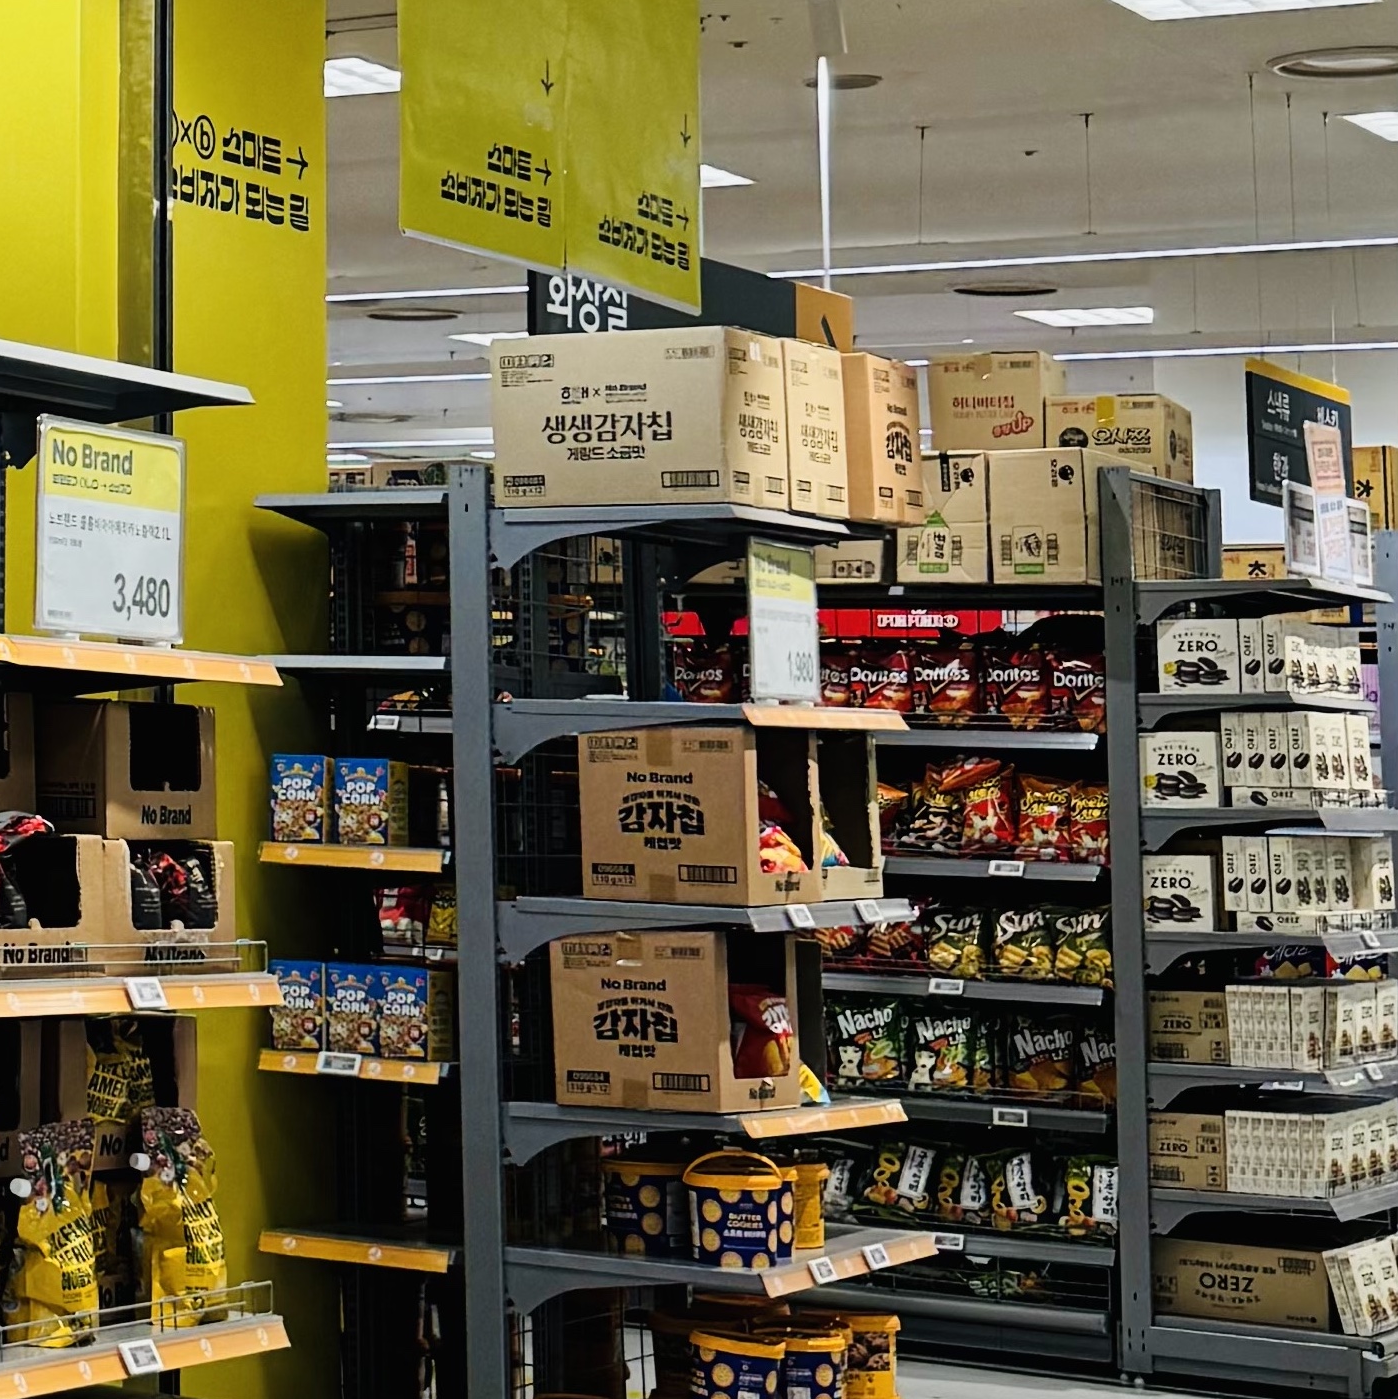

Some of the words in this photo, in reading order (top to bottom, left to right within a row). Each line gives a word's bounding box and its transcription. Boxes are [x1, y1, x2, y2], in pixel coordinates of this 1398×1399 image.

[244, 182, 284, 225] 되는
[288, 193, 311, 232] 길
[542, 411, 673, 444] 생생감자칩
[52, 438, 77, 467] No
[82, 443, 133, 476] Brand
[113, 573, 170, 621] 3,480
[1177, 640, 1218, 652] ZERO
[850, 667, 908, 684] Doritos
[914, 664, 970, 683] Doritos
[986, 667, 1040, 682] Doritos
[1054, 671, 1105, 688] Dorito
[1157, 753, 1197, 766] ZERO
[282, 777, 312, 790] POP
[346, 781, 376, 793] POP
[277, 789, 317, 802] CORN
[342, 793, 381, 805] CORN
[618, 801, 705, 836] 감자칩
[1151, 877, 1191, 889] ZERO
[281, 985, 311, 997] POP
[336, 989, 366, 1001] POP
[332, 1000, 371, 1014] CORN
[593, 1008, 679, 1044] 감자칩
[837, 1007, 893, 1040] Nacho
[915, 1016, 972, 1044] Nacho
[1013, 1028, 1074, 1059] Nacho
[1199, 1271, 1254, 1293] ZERO
